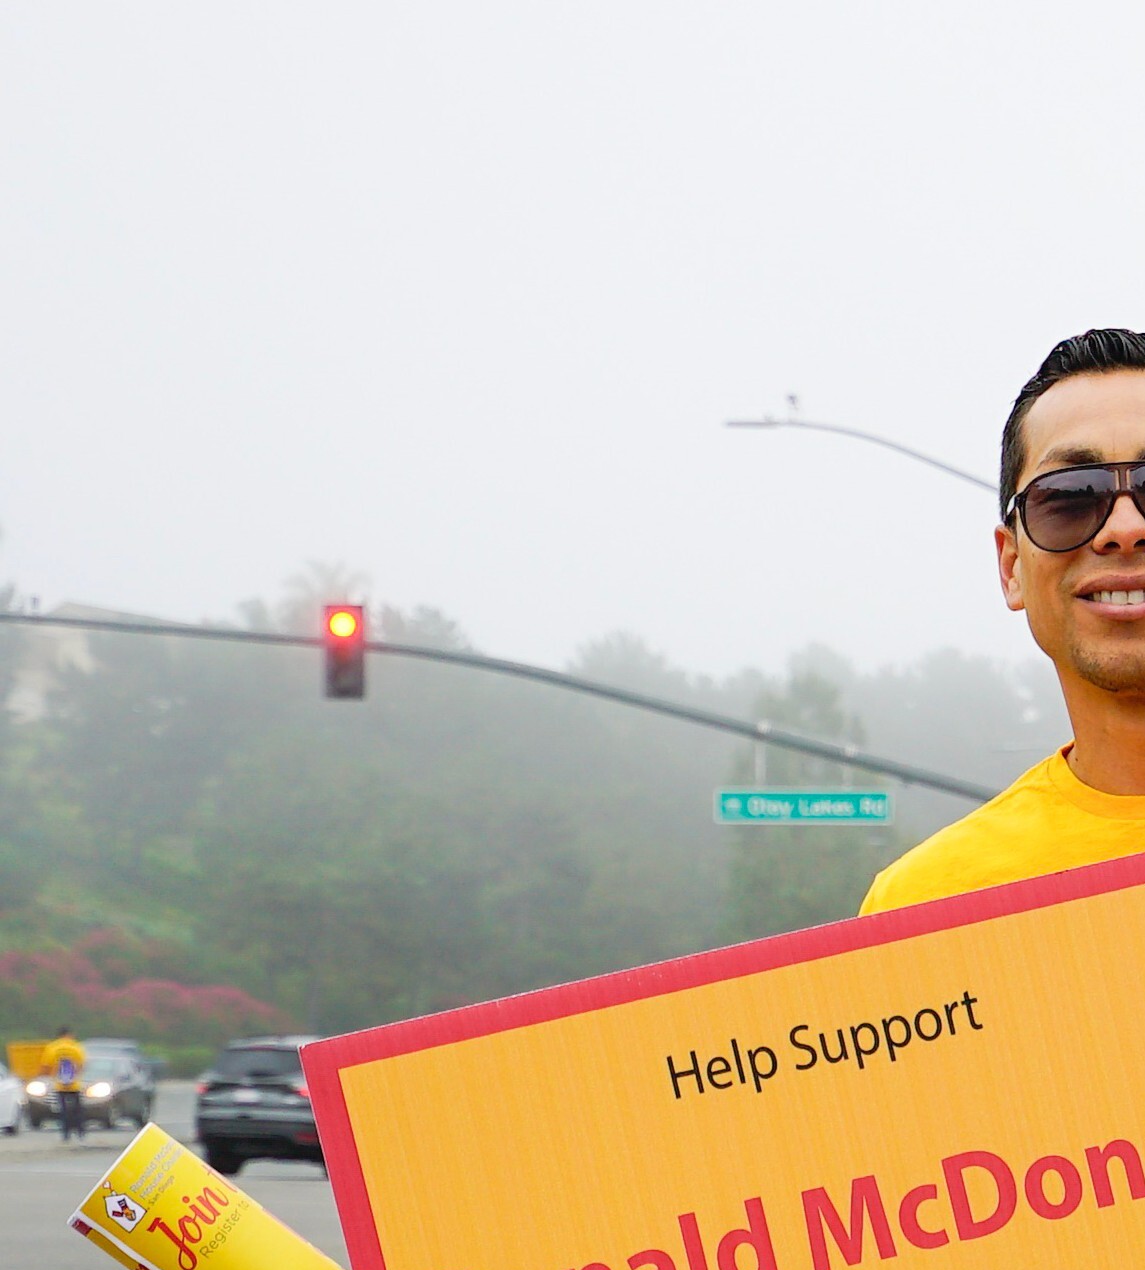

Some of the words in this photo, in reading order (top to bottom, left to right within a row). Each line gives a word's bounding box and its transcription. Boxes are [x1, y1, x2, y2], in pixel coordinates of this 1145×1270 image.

[798, 798, 856, 818] Lakes
[666, 1037, 779, 1100] Help
[789, 990, 984, 1070] Support
[147, 1187, 229, 1270] Join
[199, 1208, 242, 1258] Register
